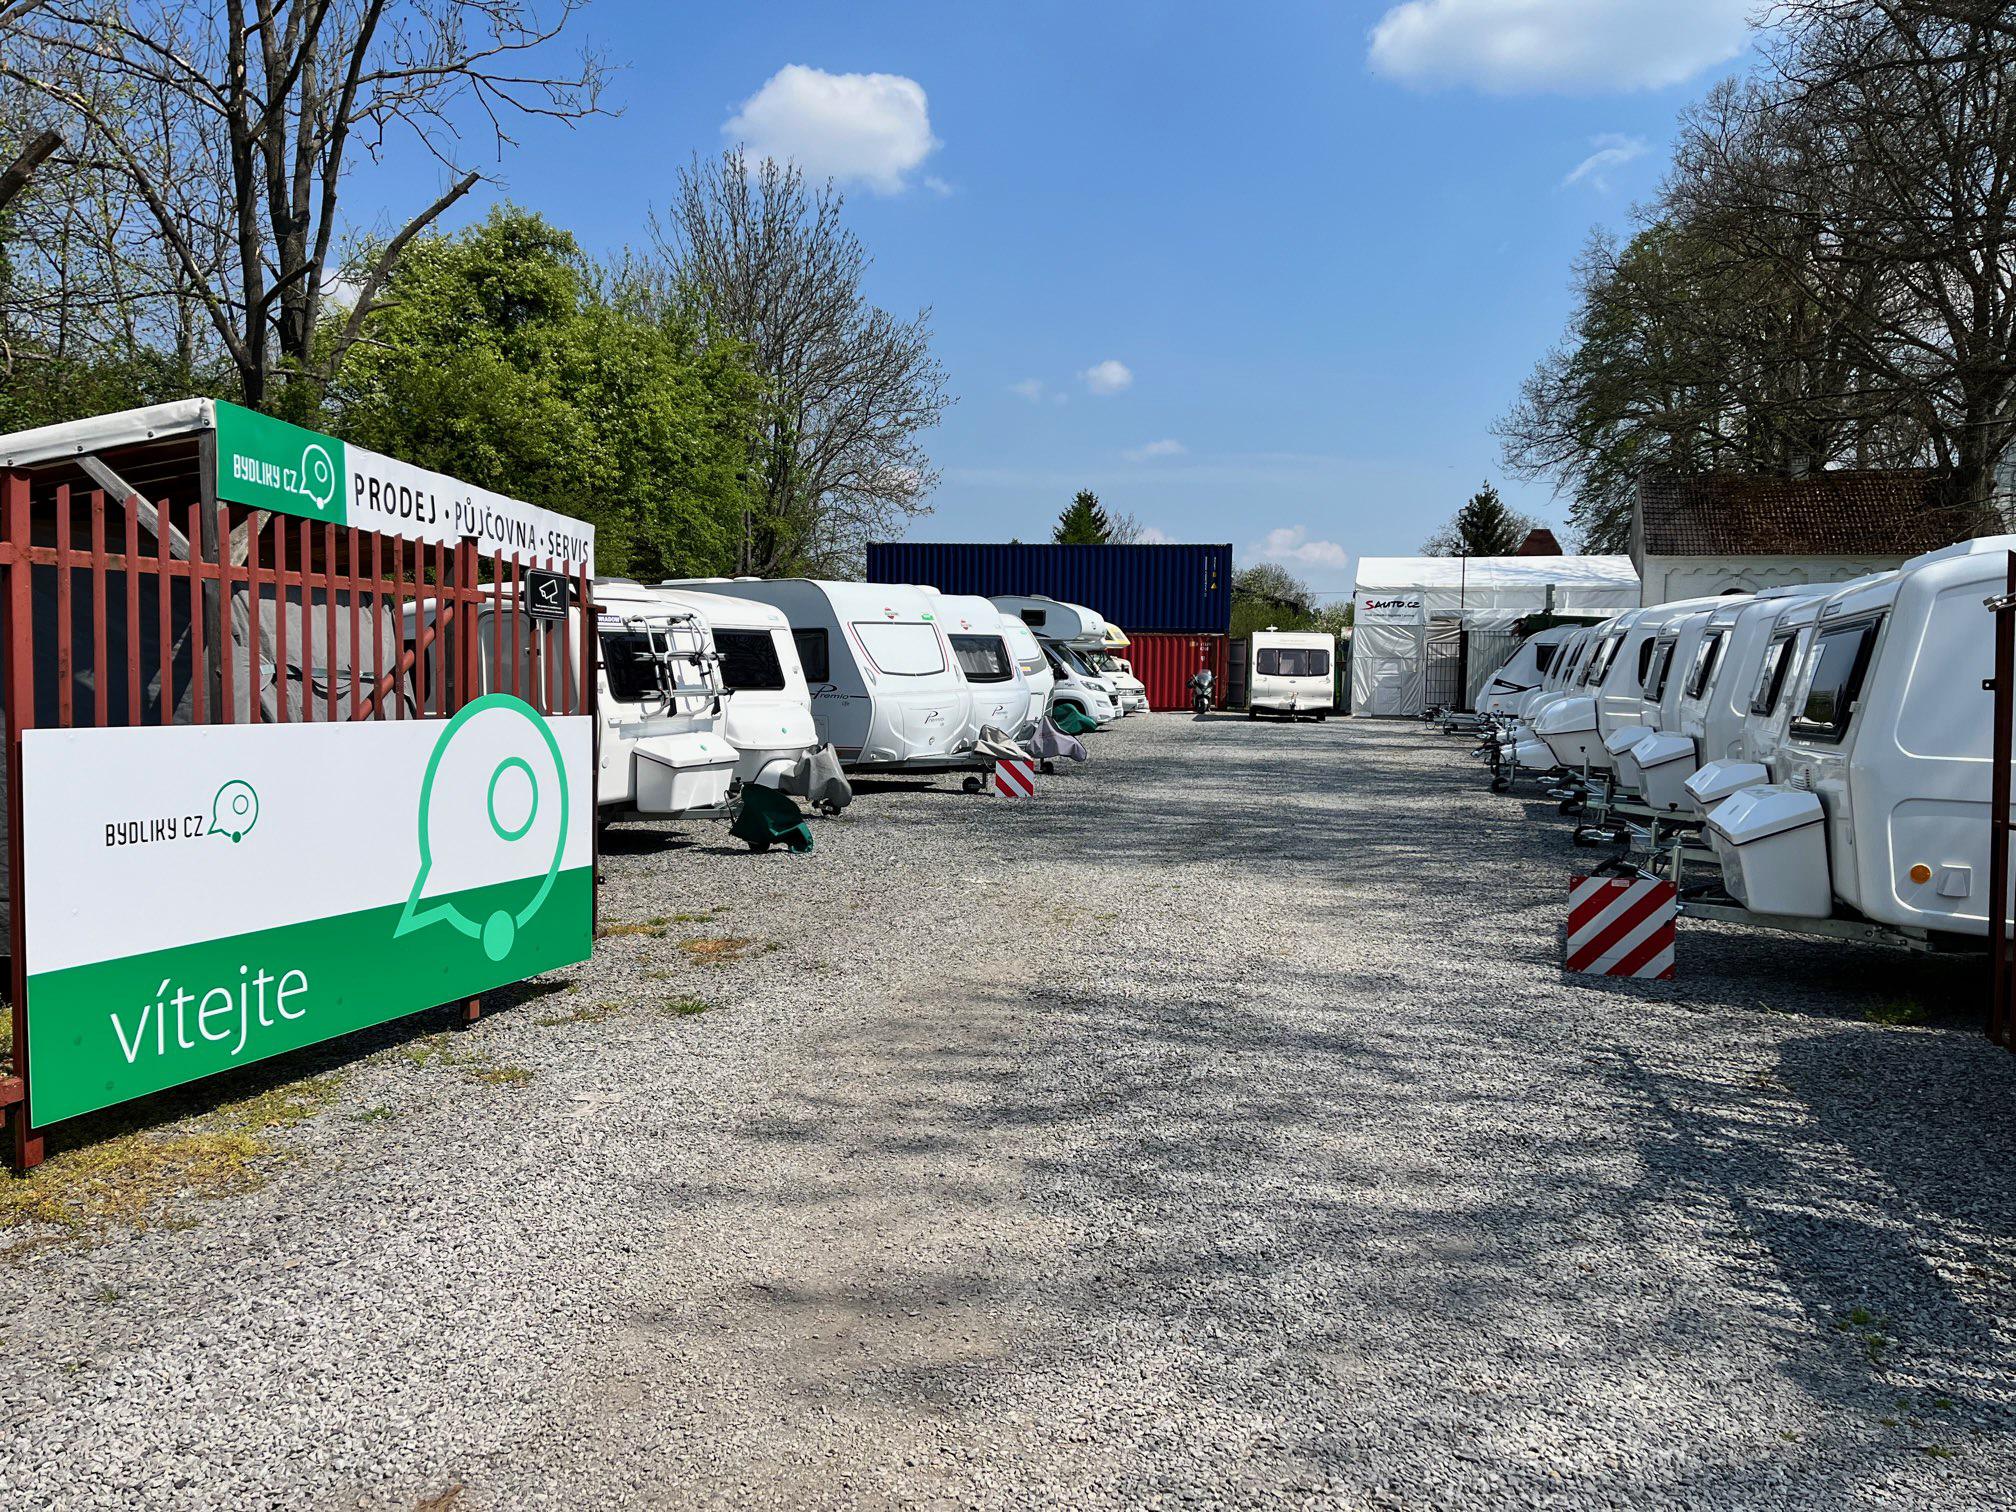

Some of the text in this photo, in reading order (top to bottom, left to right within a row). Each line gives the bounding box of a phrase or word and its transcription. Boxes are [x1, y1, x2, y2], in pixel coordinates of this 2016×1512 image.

[233, 453, 298, 494] BYDLIKY CZ
[354, 472, 589, 564] PRODEJ PŮJČOVNA SERVIS
[813, 684, 849, 700] Premio
[105, 815, 204, 847] BYDLIKY CZ
[110, 964, 309, 1064] vítejte
